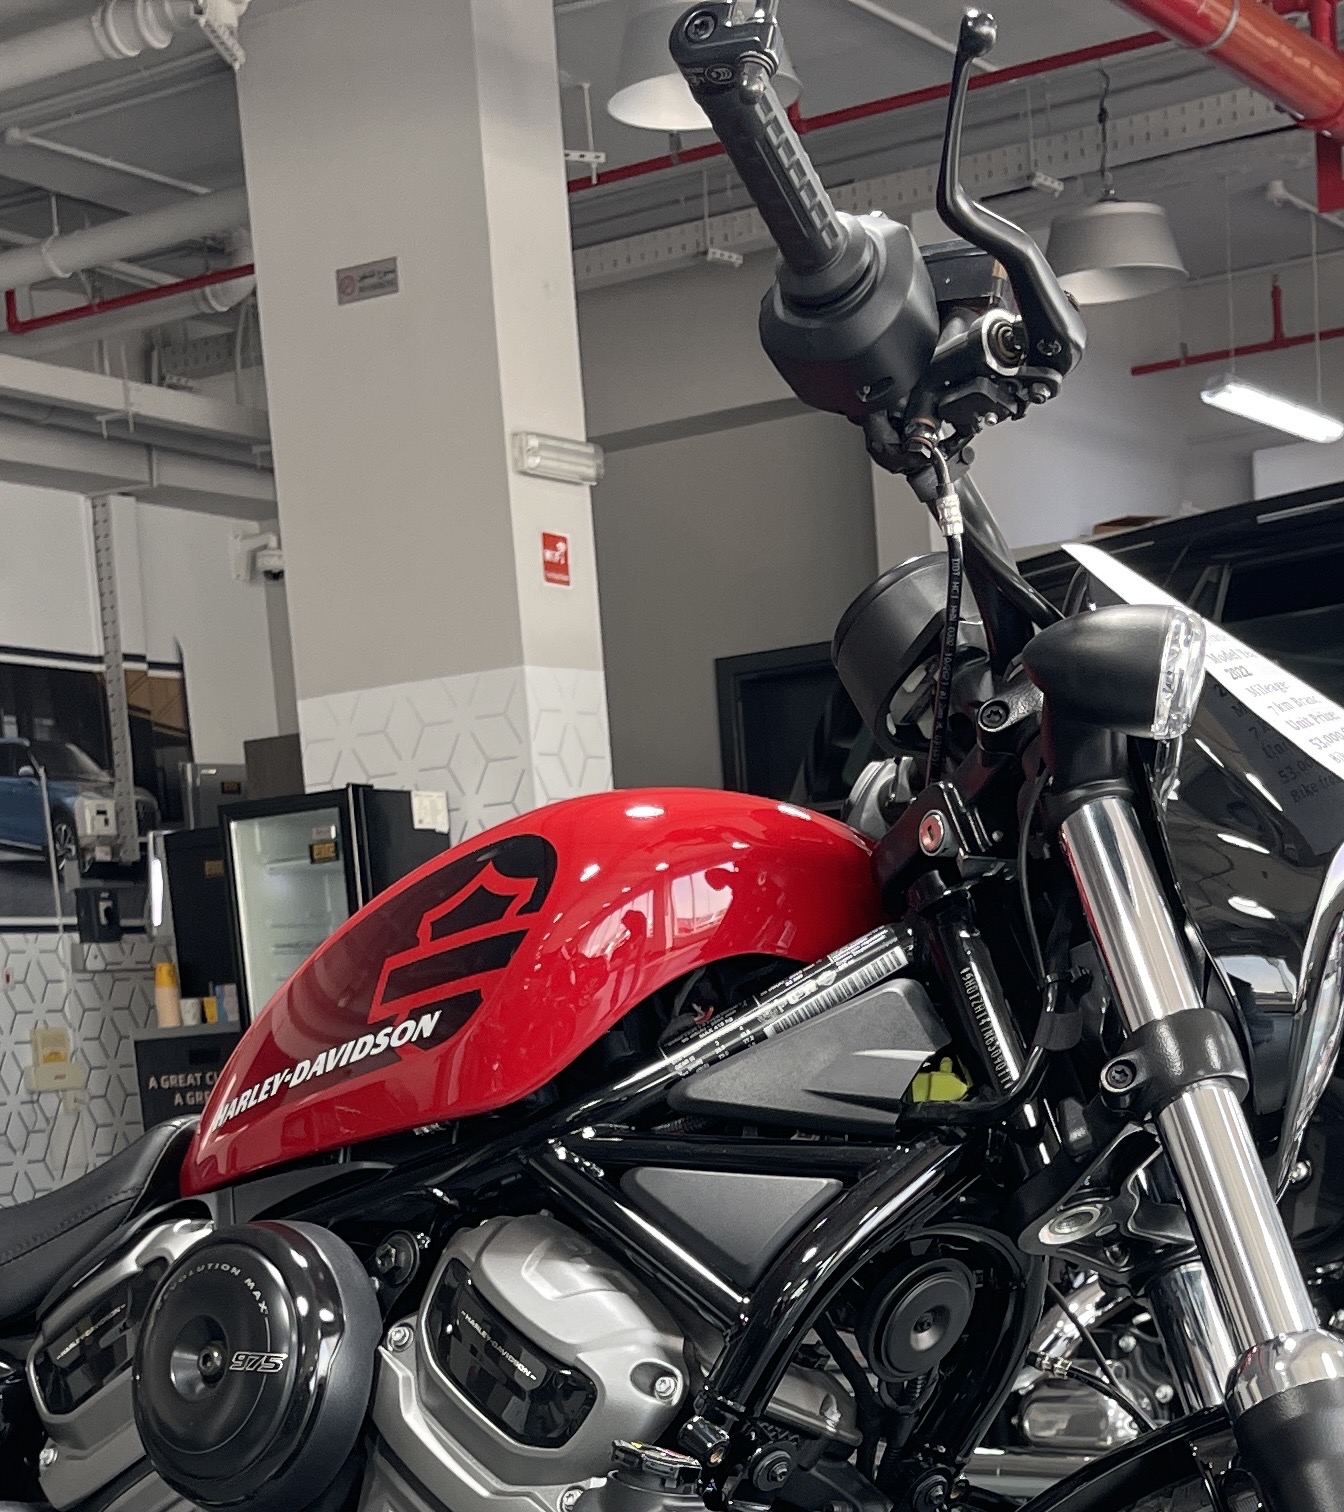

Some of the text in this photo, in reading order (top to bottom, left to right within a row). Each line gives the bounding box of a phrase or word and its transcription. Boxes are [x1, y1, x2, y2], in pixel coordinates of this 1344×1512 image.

[1223, 665, 1254, 681] 2022
[211, 1009, 443, 1131] HARLEY-DAVIDSON
[148, 1076, 159, 1090] A
[160, 1071, 203, 1089] GREAT
[173, 1093, 184, 1106] A
[229, 1350, 289, 1373] 975
